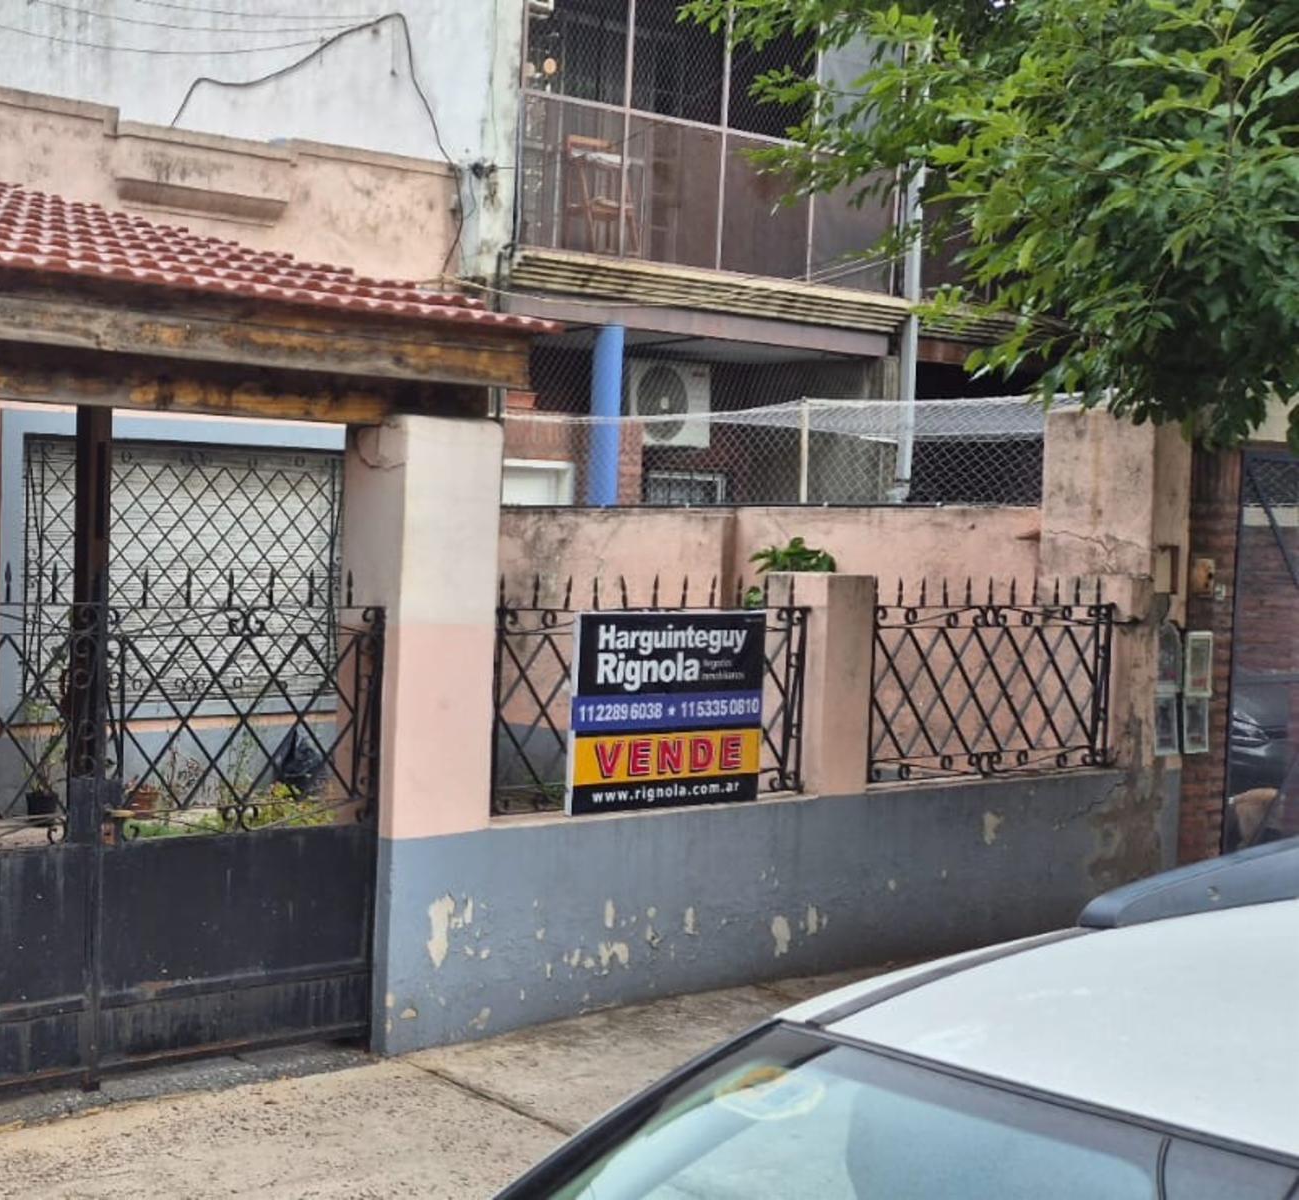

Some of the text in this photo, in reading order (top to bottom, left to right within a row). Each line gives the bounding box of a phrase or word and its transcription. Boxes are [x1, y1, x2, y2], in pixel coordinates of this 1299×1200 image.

[598, 624, 748, 656] Harguinteguy
[596, 652, 701, 692] Rignola
[596, 734, 744, 778] VENDE
[592, 780, 740, 803] www.rignola.com.ar
